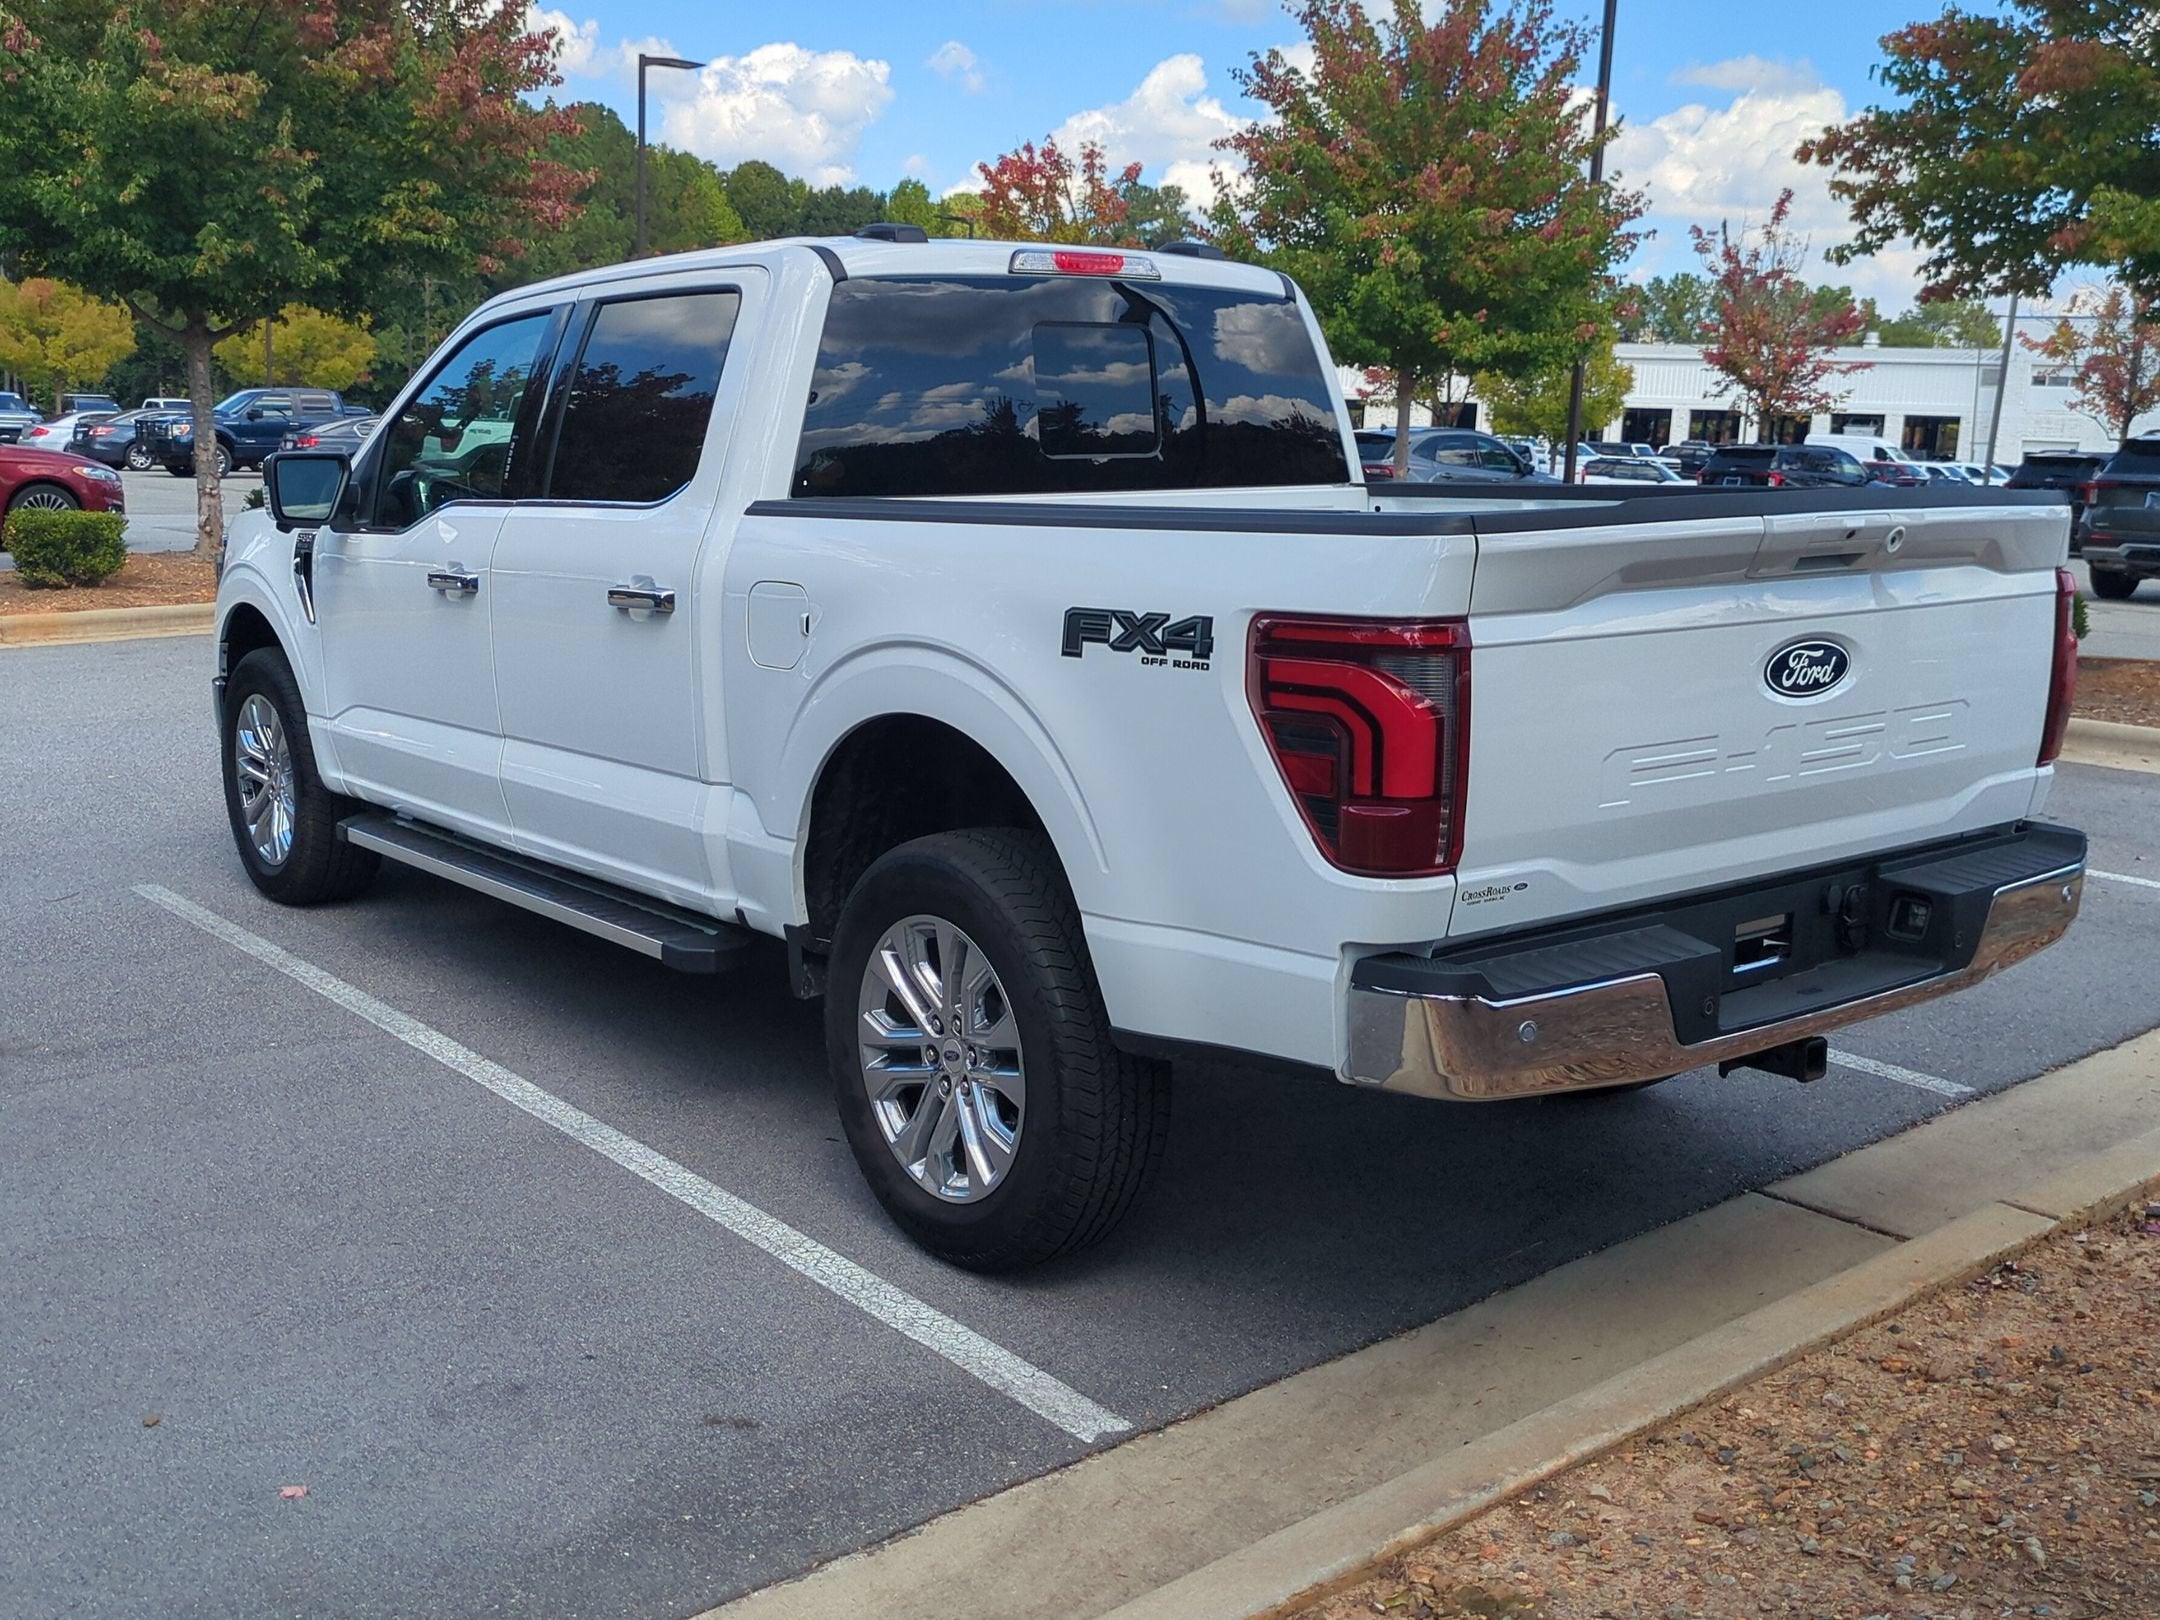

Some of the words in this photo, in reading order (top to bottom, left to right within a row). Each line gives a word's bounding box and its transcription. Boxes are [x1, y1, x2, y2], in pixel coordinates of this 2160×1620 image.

[1061, 606, 1214, 660] FX4
[1141, 656, 1168, 667] OFF
[1172, 659, 1210, 671] ROAD
[1782, 649, 1837, 687] Ford
